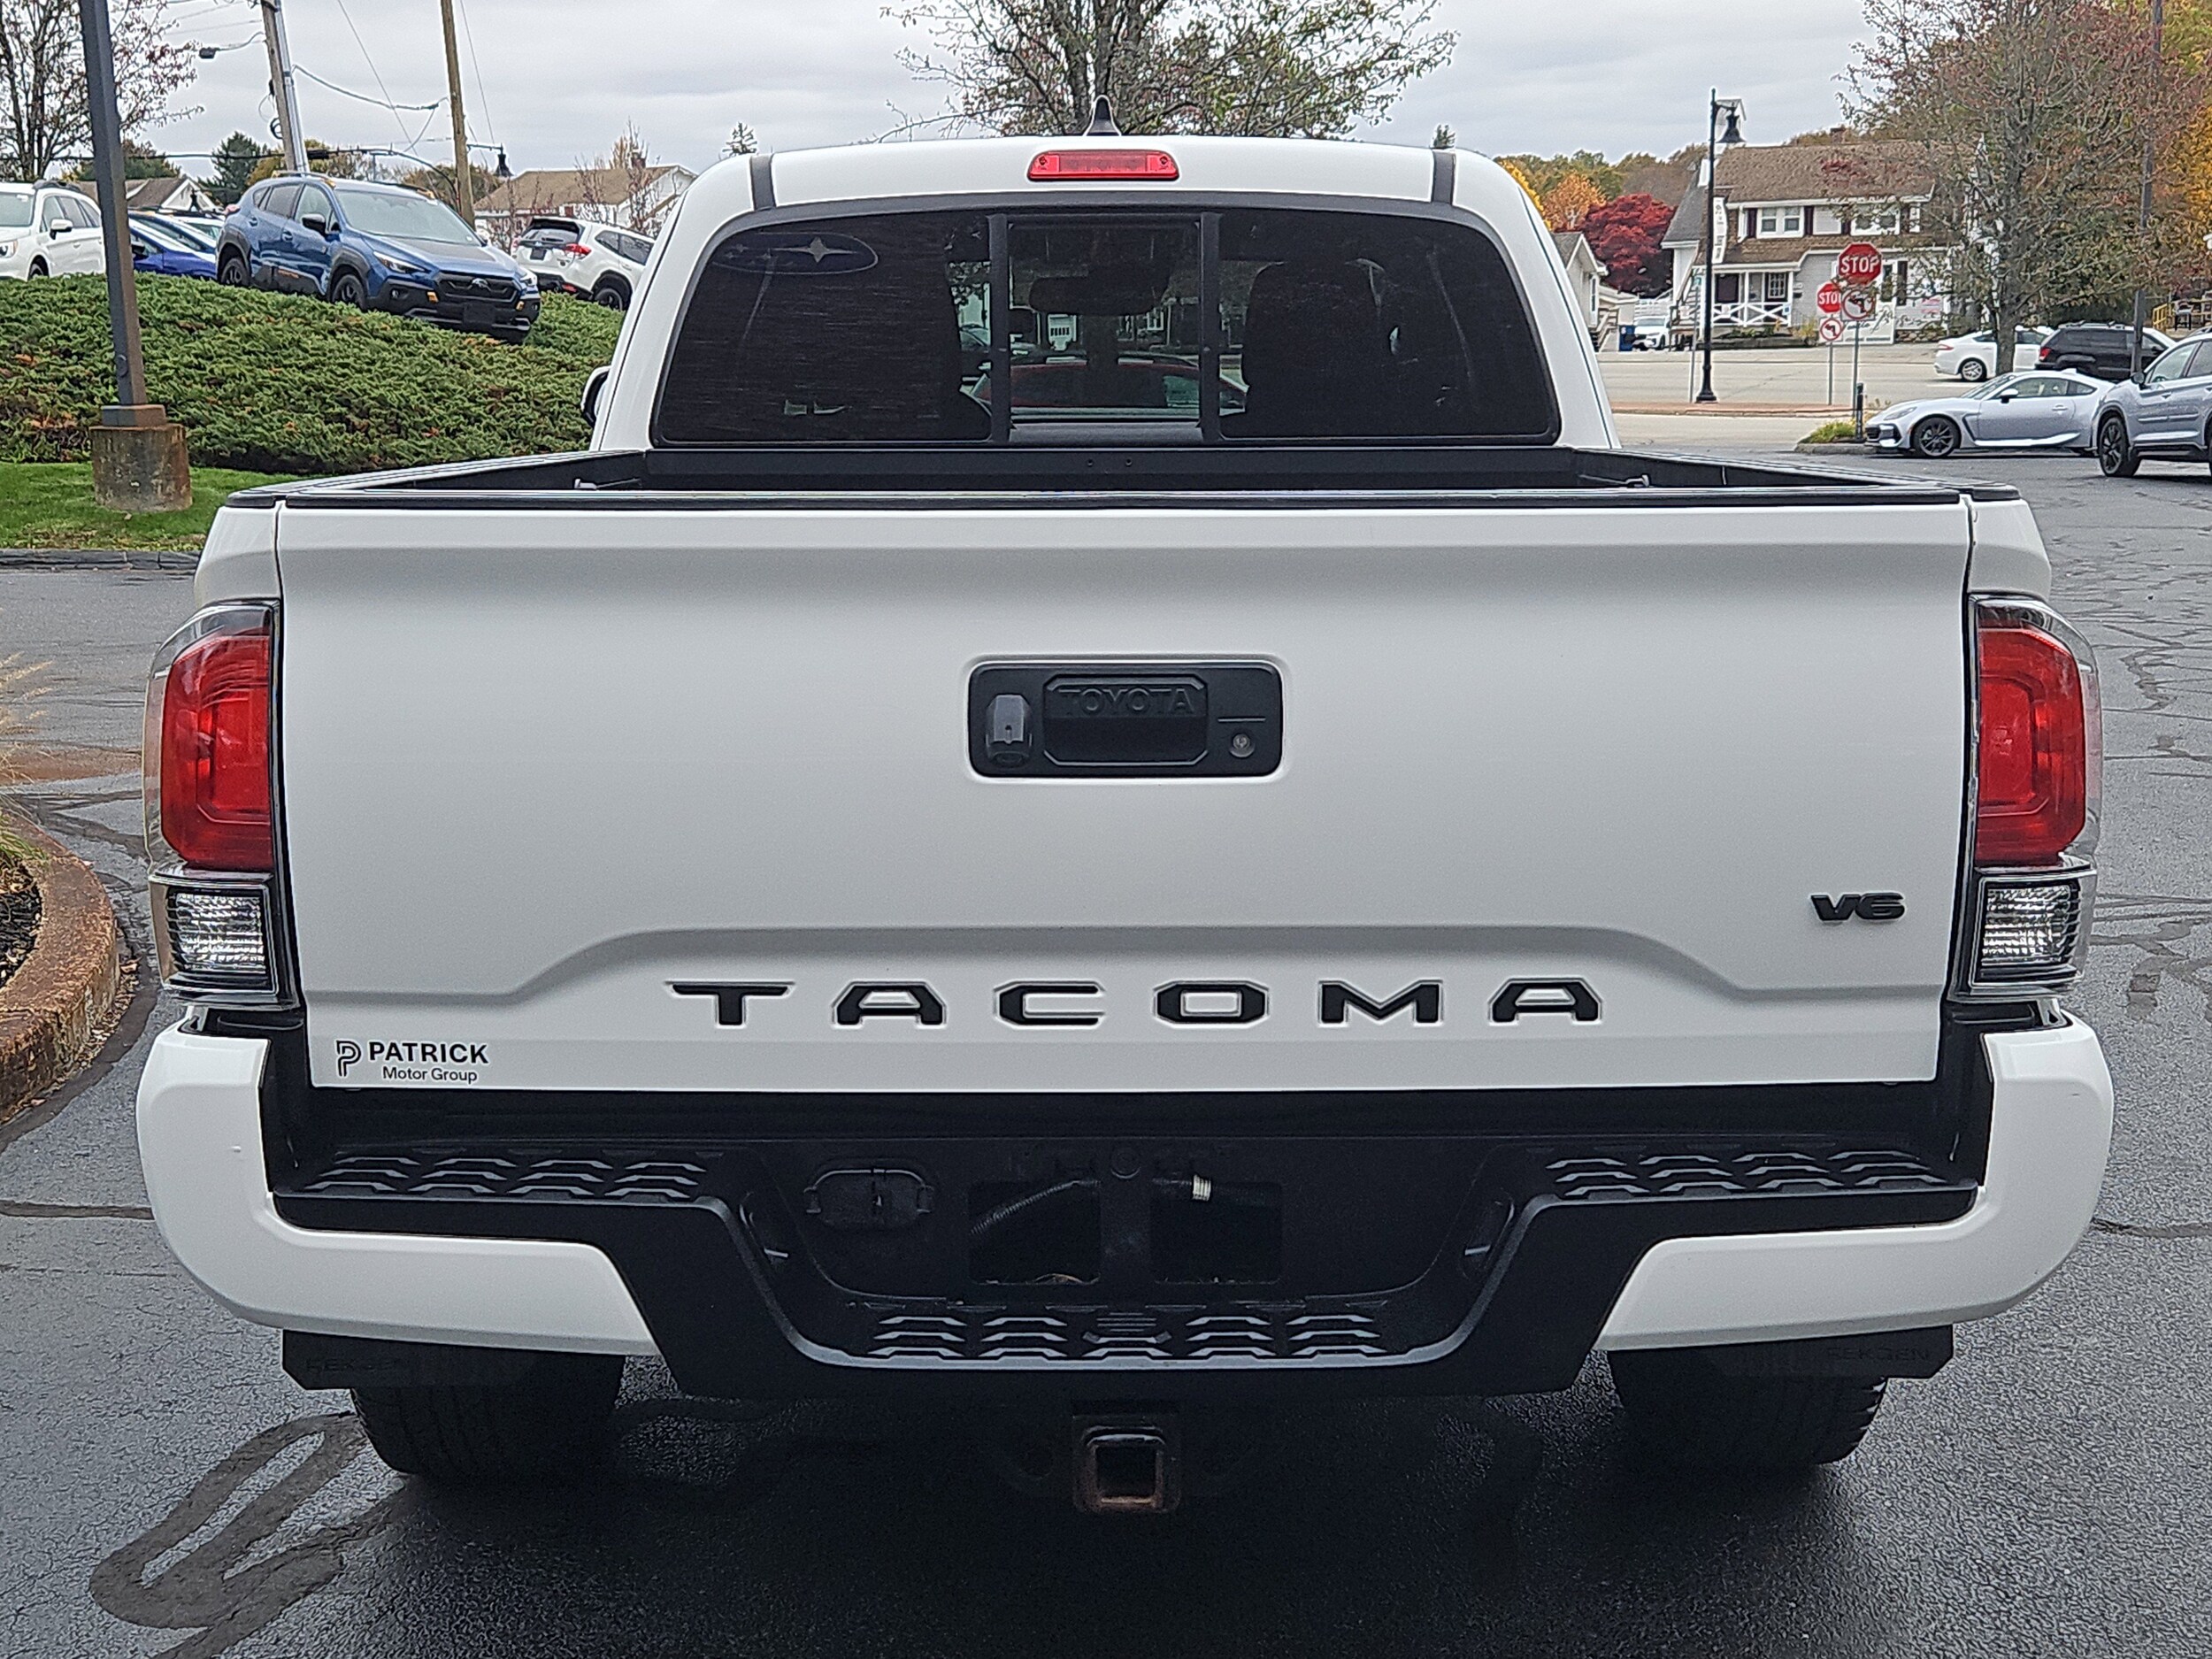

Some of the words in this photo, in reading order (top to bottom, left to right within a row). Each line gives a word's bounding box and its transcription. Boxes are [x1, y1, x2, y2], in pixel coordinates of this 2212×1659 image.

[1841, 255, 1880, 273] STOP
[1818, 291, 1841, 304] STO
[1059, 687, 1194, 714] TOYOTA
[1810, 892, 1905, 921] V6
[664, 978, 1602, 1026] TACOMA
[368, 1041, 489, 1064] PATRICK
[383, 1066, 427, 1080] Motor
[431, 1068, 478, 1085] Group
